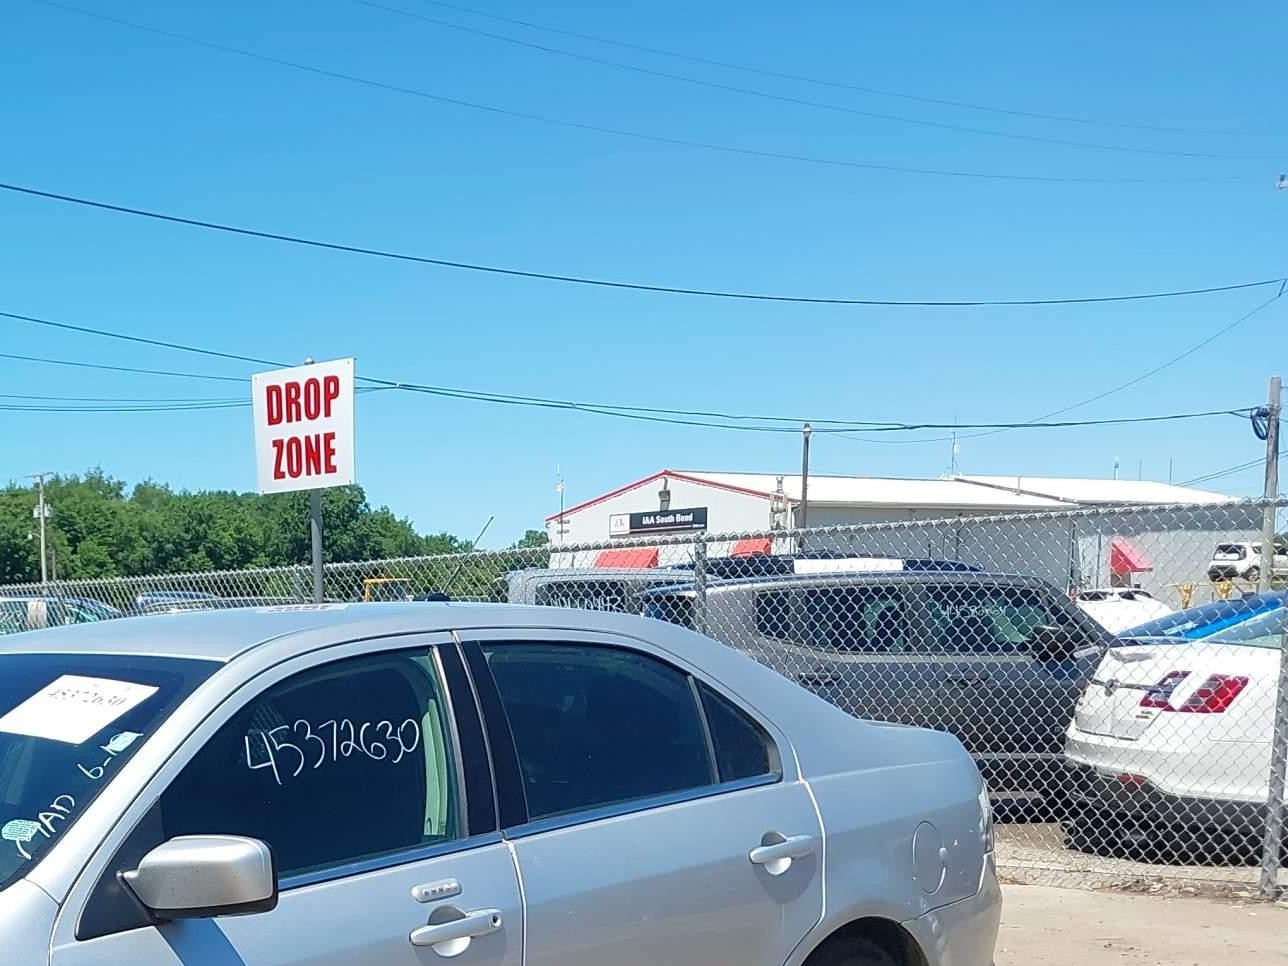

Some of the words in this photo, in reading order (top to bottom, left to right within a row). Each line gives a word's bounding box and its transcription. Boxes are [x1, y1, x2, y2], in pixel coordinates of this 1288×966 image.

[266, 375, 340, 426] DROP
[272, 432, 338, 481] ZONE
[642, 515, 655, 526] IAA
[655, 513, 675, 524] South
[676, 512, 693, 523] Bend
[244, 718, 420, 786] 45372630
